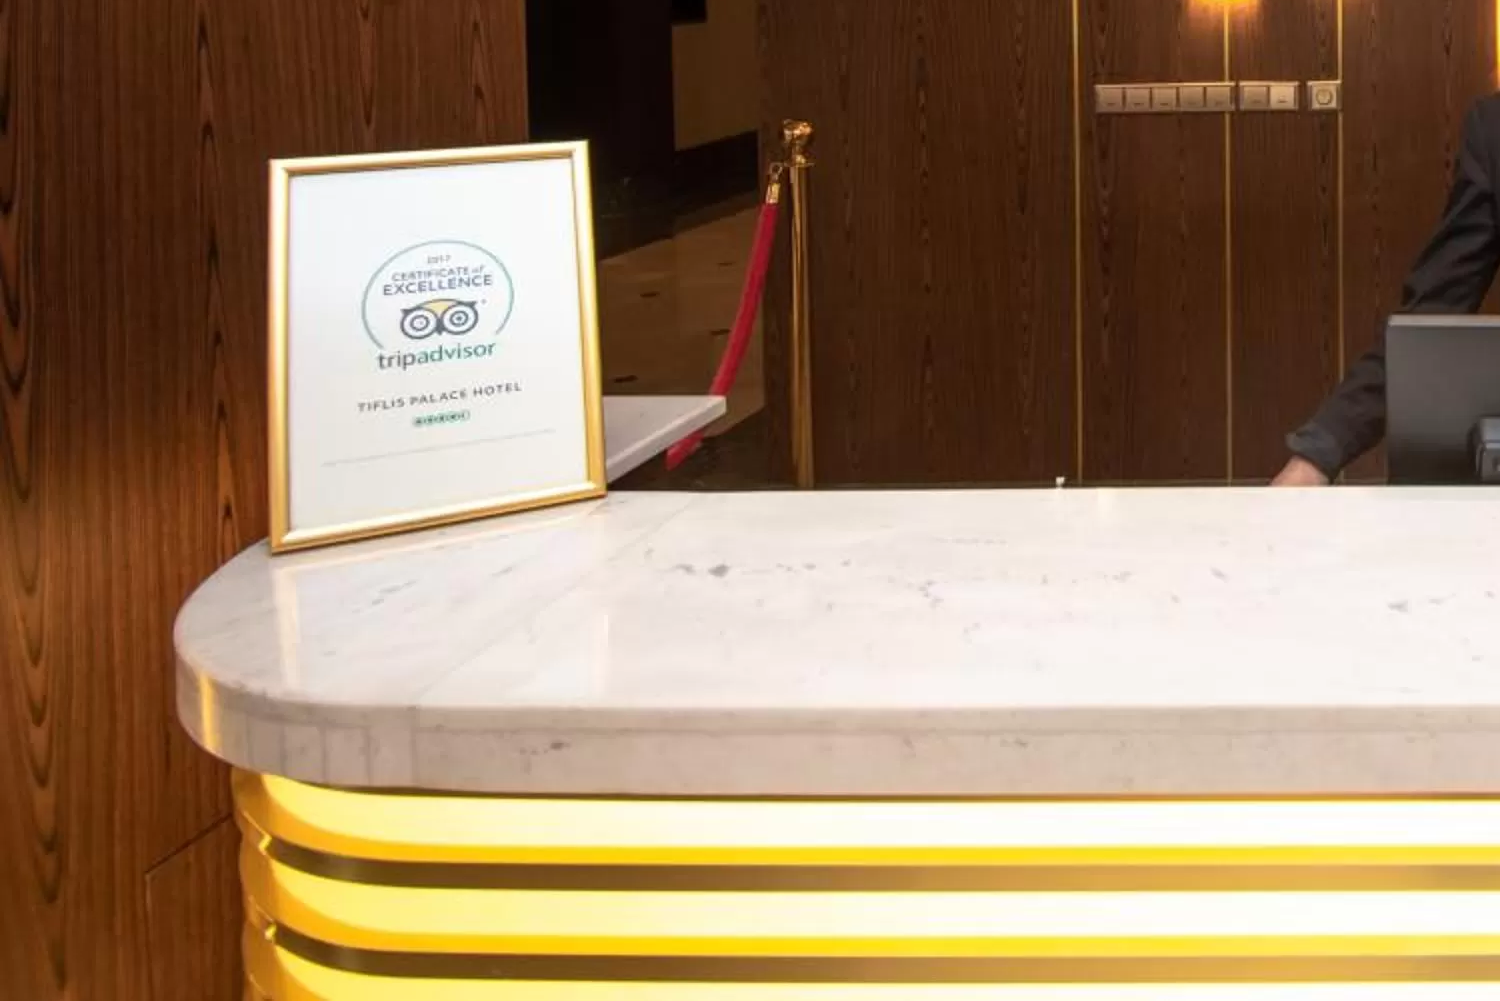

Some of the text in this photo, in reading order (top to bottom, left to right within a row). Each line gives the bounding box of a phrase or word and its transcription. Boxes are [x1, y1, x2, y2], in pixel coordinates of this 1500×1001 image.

[383, 274, 493, 296] EXCELLENCE
[391, 266, 469, 282] CERTIFICATE
[377, 342, 496, 371] tripadvisor
[357, 382, 522, 412] TIFLIS PALACE HOTEL
